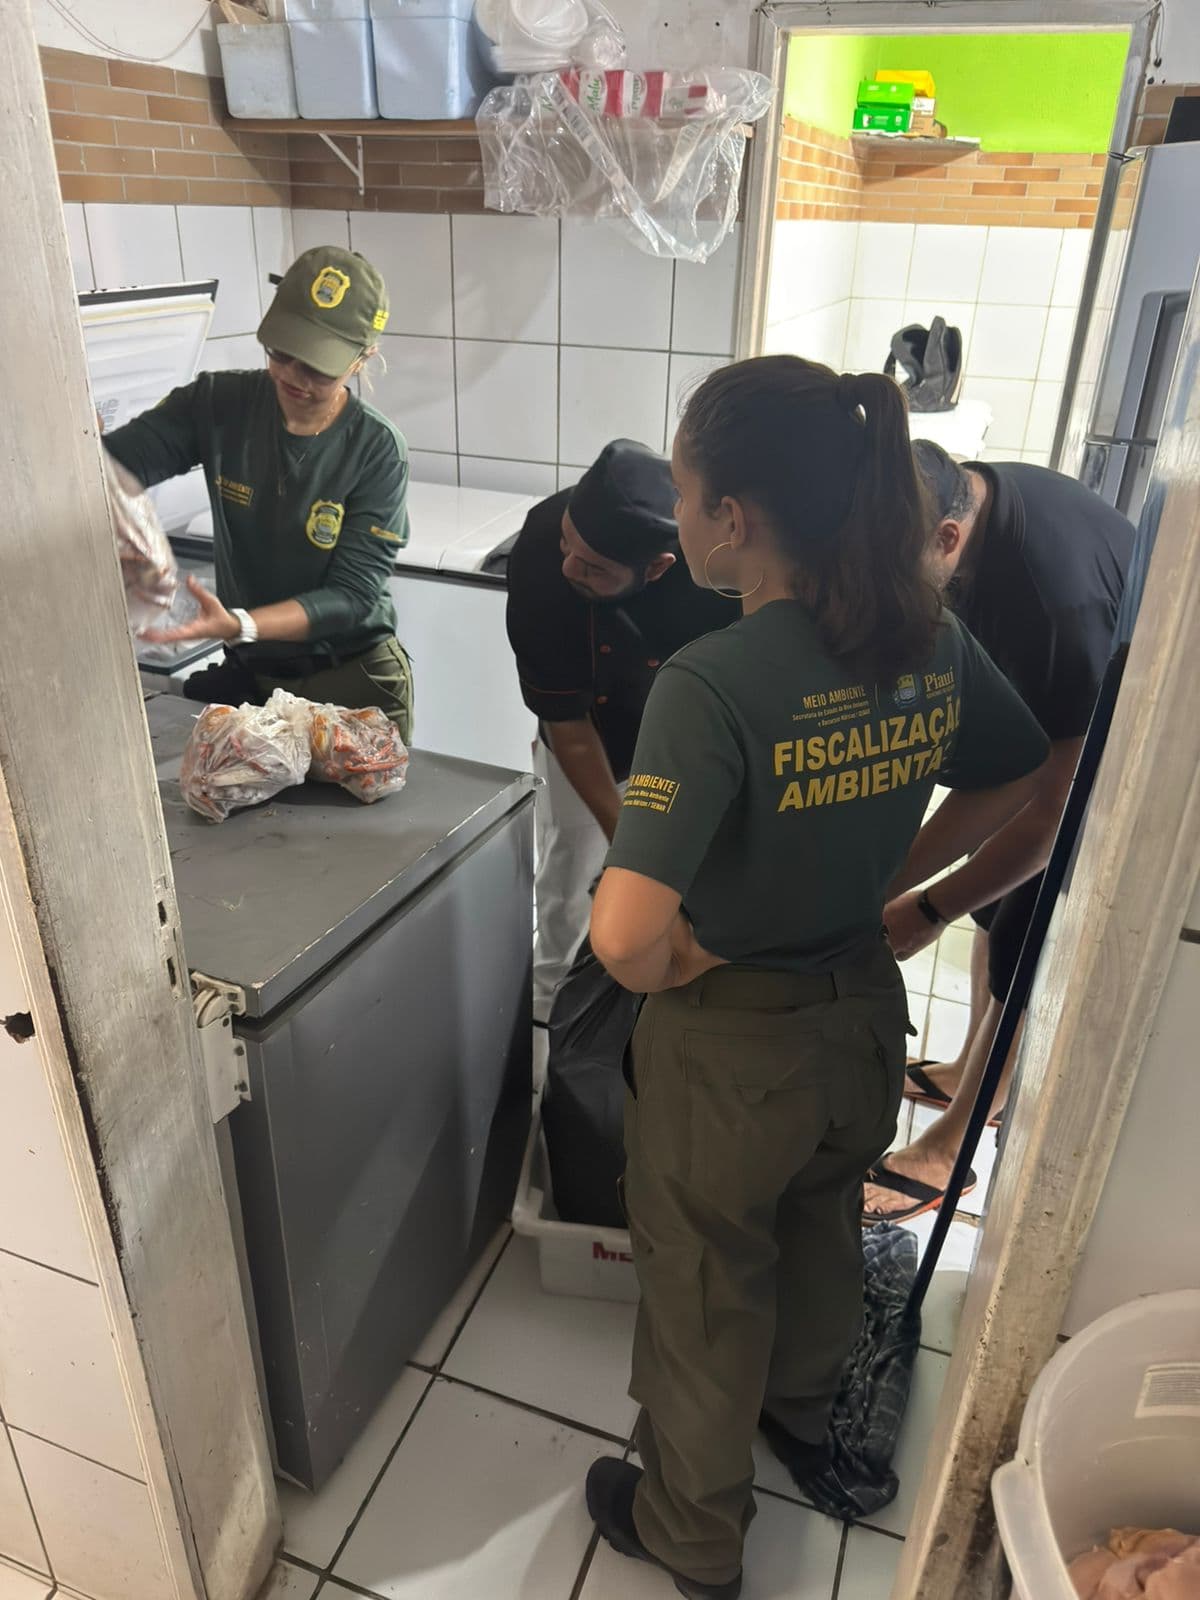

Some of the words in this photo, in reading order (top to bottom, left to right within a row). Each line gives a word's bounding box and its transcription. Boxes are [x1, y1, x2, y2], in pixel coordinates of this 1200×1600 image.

[924, 666, 955, 692] Piauí
[803, 693, 827, 709] MEIO
[828, 686, 867, 704] AMBIENTE
